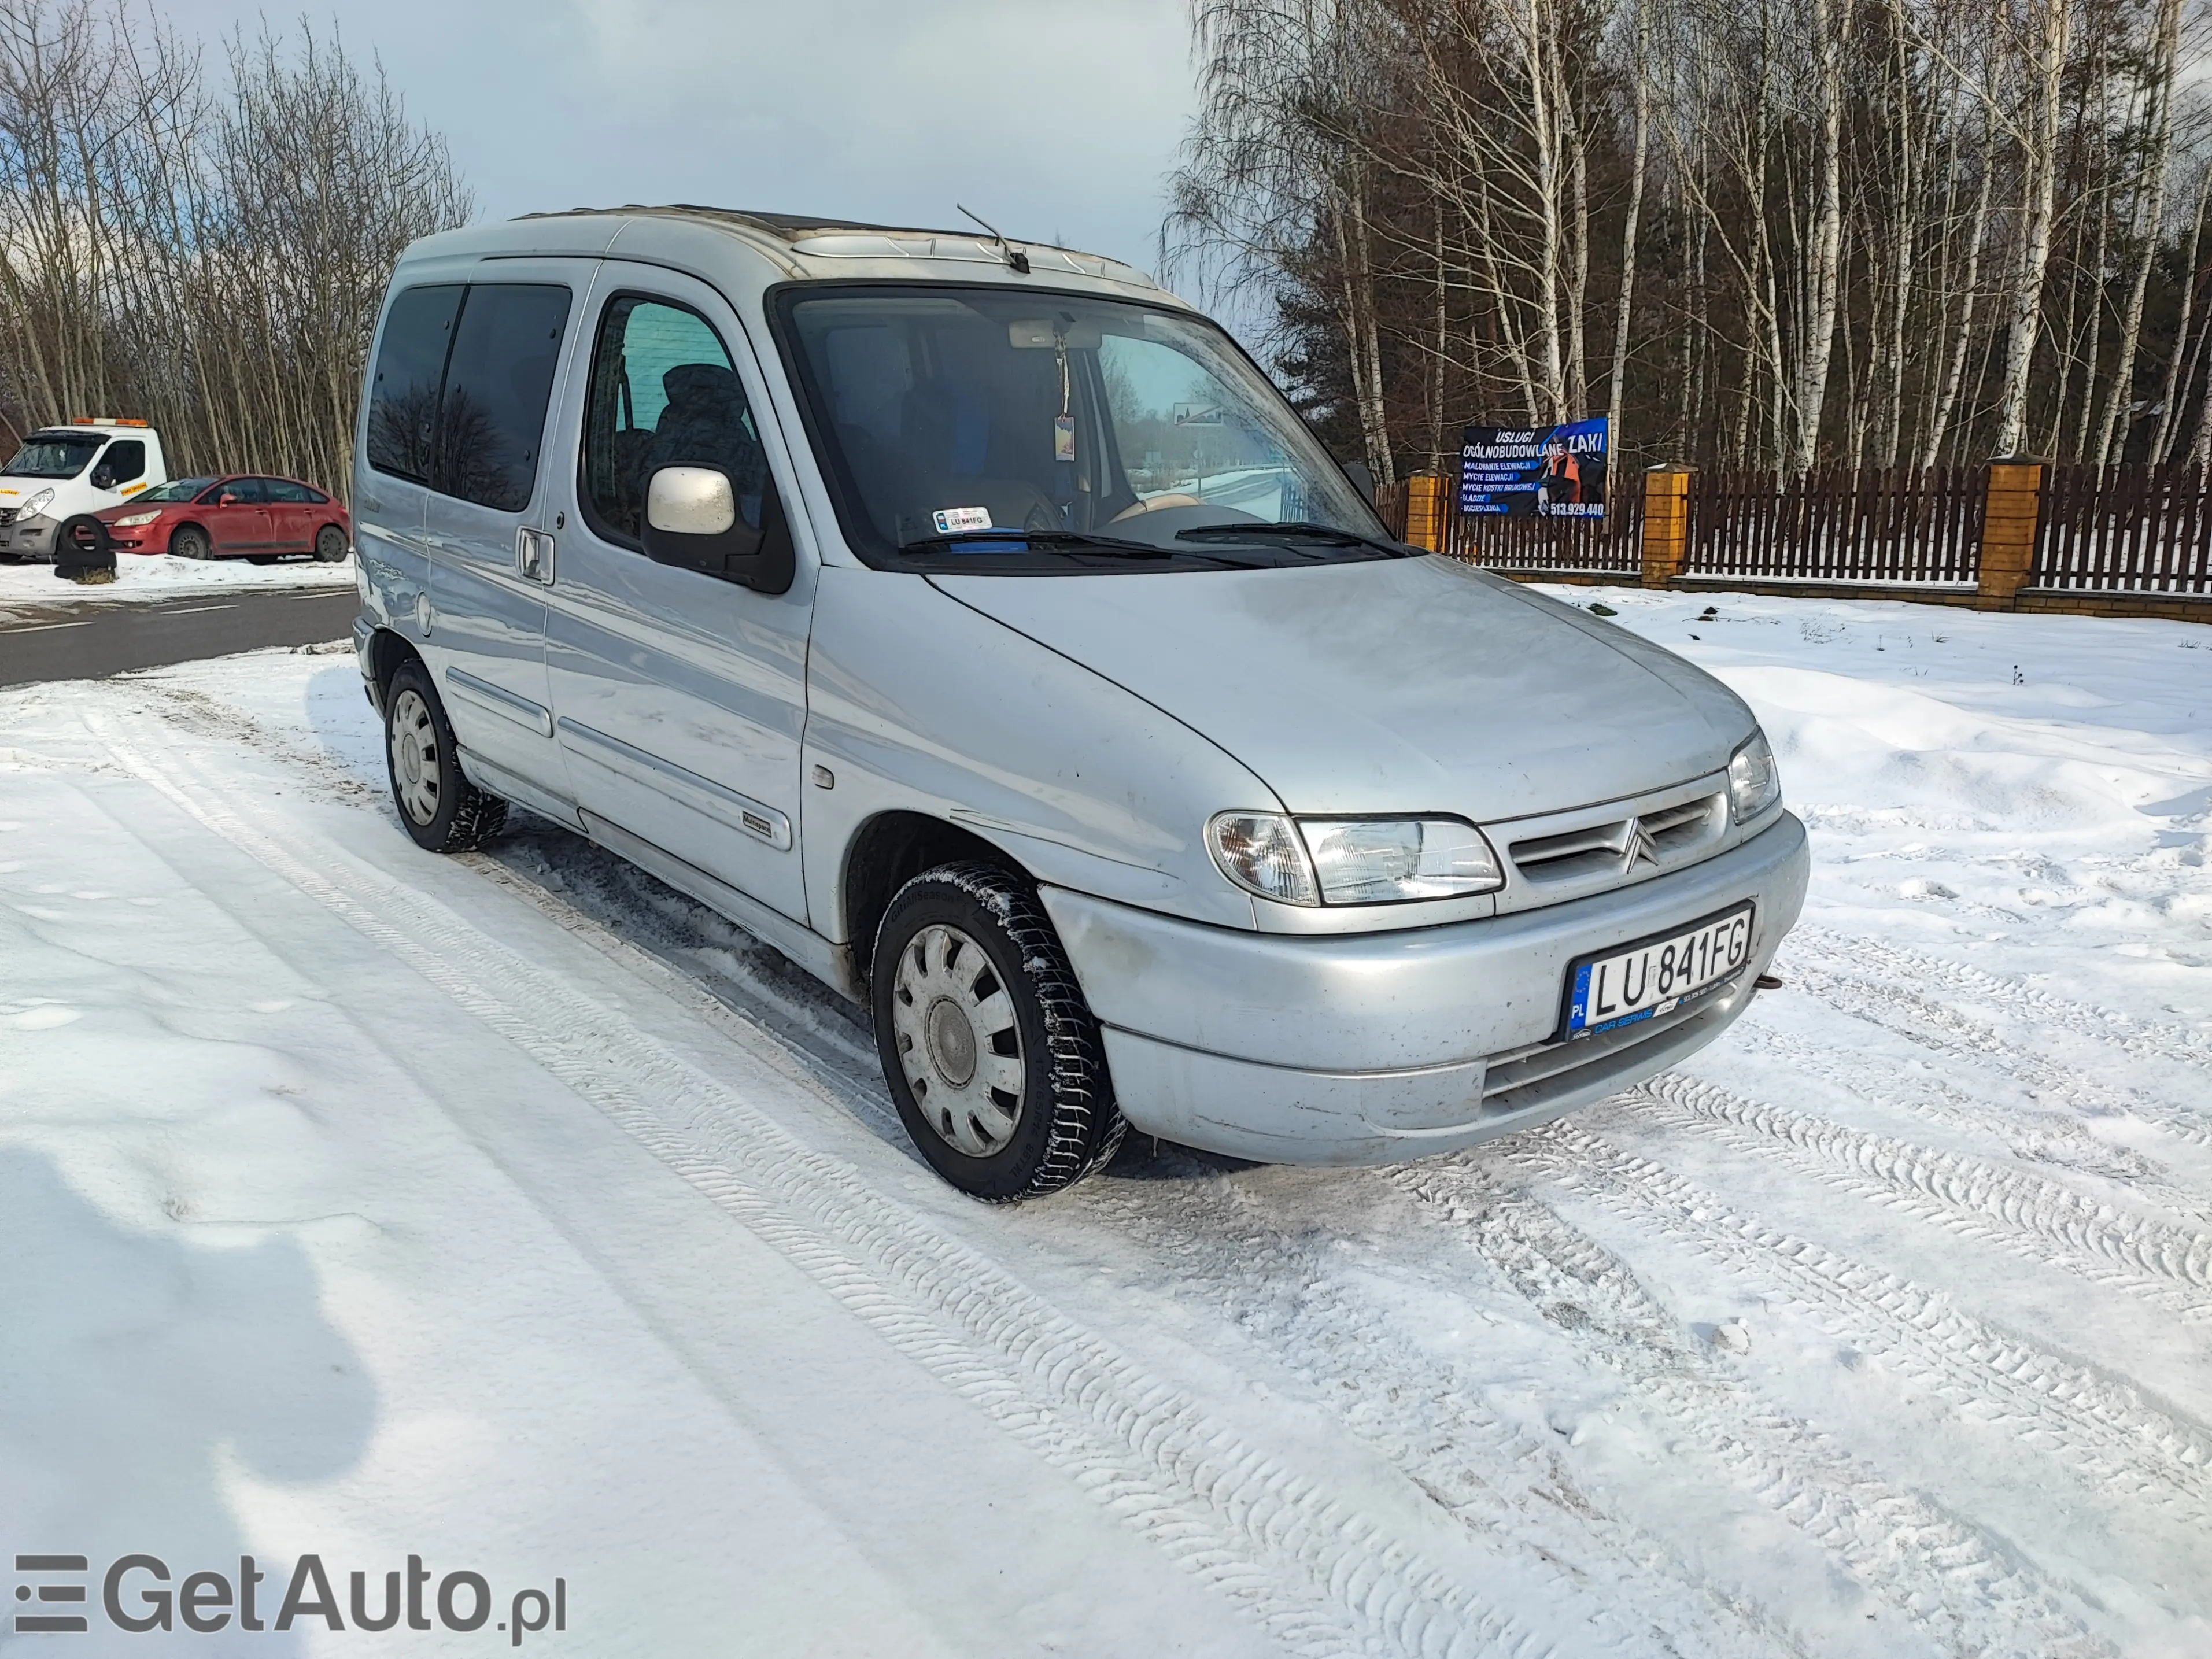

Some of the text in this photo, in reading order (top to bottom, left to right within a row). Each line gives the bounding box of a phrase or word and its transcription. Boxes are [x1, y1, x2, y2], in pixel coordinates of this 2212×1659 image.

[1463, 442, 1564, 458] OGÓLNOBUDOWLANE
[1568, 433, 1602, 453] ZAKI
[1463, 472, 1513, 481] MYCIE ELEWACJI
[1463, 483, 1482, 491] MYCIE
[1504, 483, 1535, 491] BRUKOWEJ
[1550, 503, 1604, 515] 513.929.440
[1596, 918, 1745, 1017] LU 841FG
[1571, 1004, 1584, 1019] PL
[1595, 1008, 1653, 1034] CAR SERWIS
